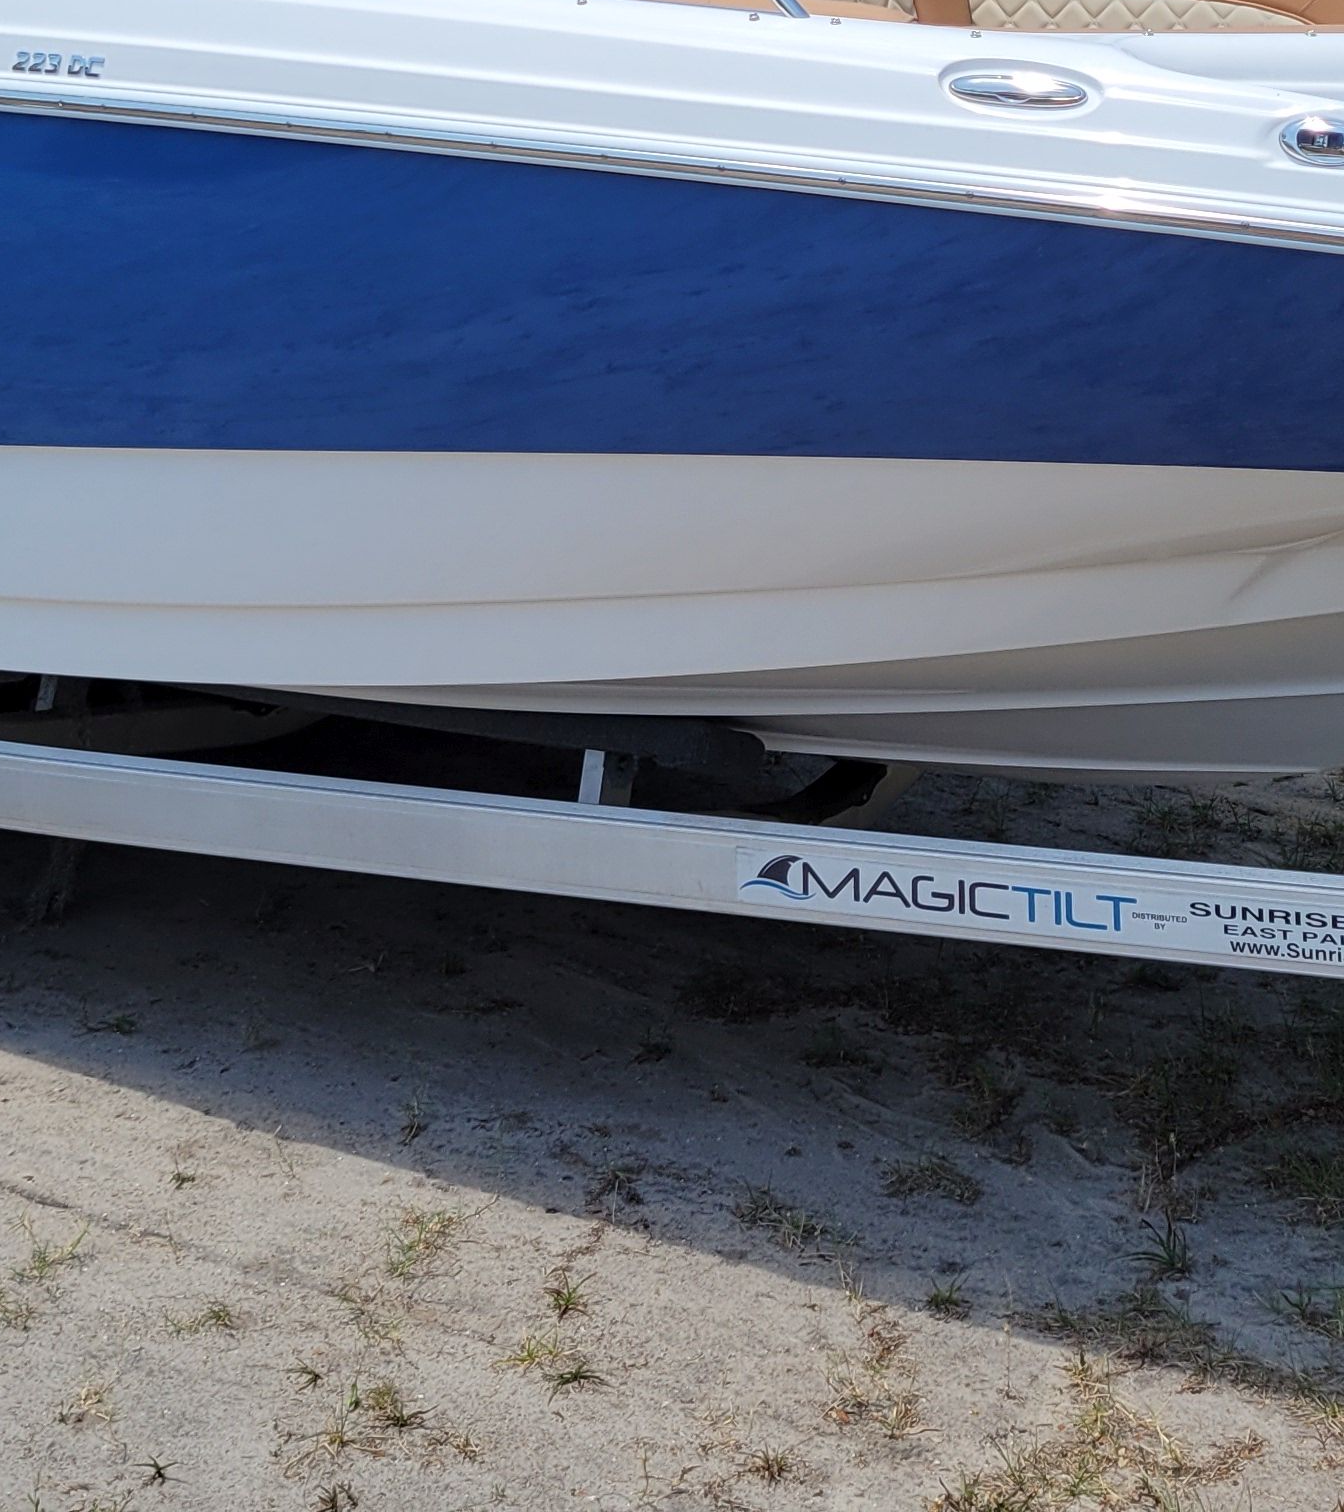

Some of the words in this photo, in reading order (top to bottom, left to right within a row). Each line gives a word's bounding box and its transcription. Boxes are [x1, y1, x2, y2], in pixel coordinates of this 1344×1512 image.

[12, 51, 62, 74] 223
[67, 55, 106, 77] DC
[800, 861, 1137, 932] MAGICTILT
[1131, 911, 1188, 924] DISTRIBUTED
[1154, 922, 1166, 931] BY
[1223, 924, 1293, 942] EAST
